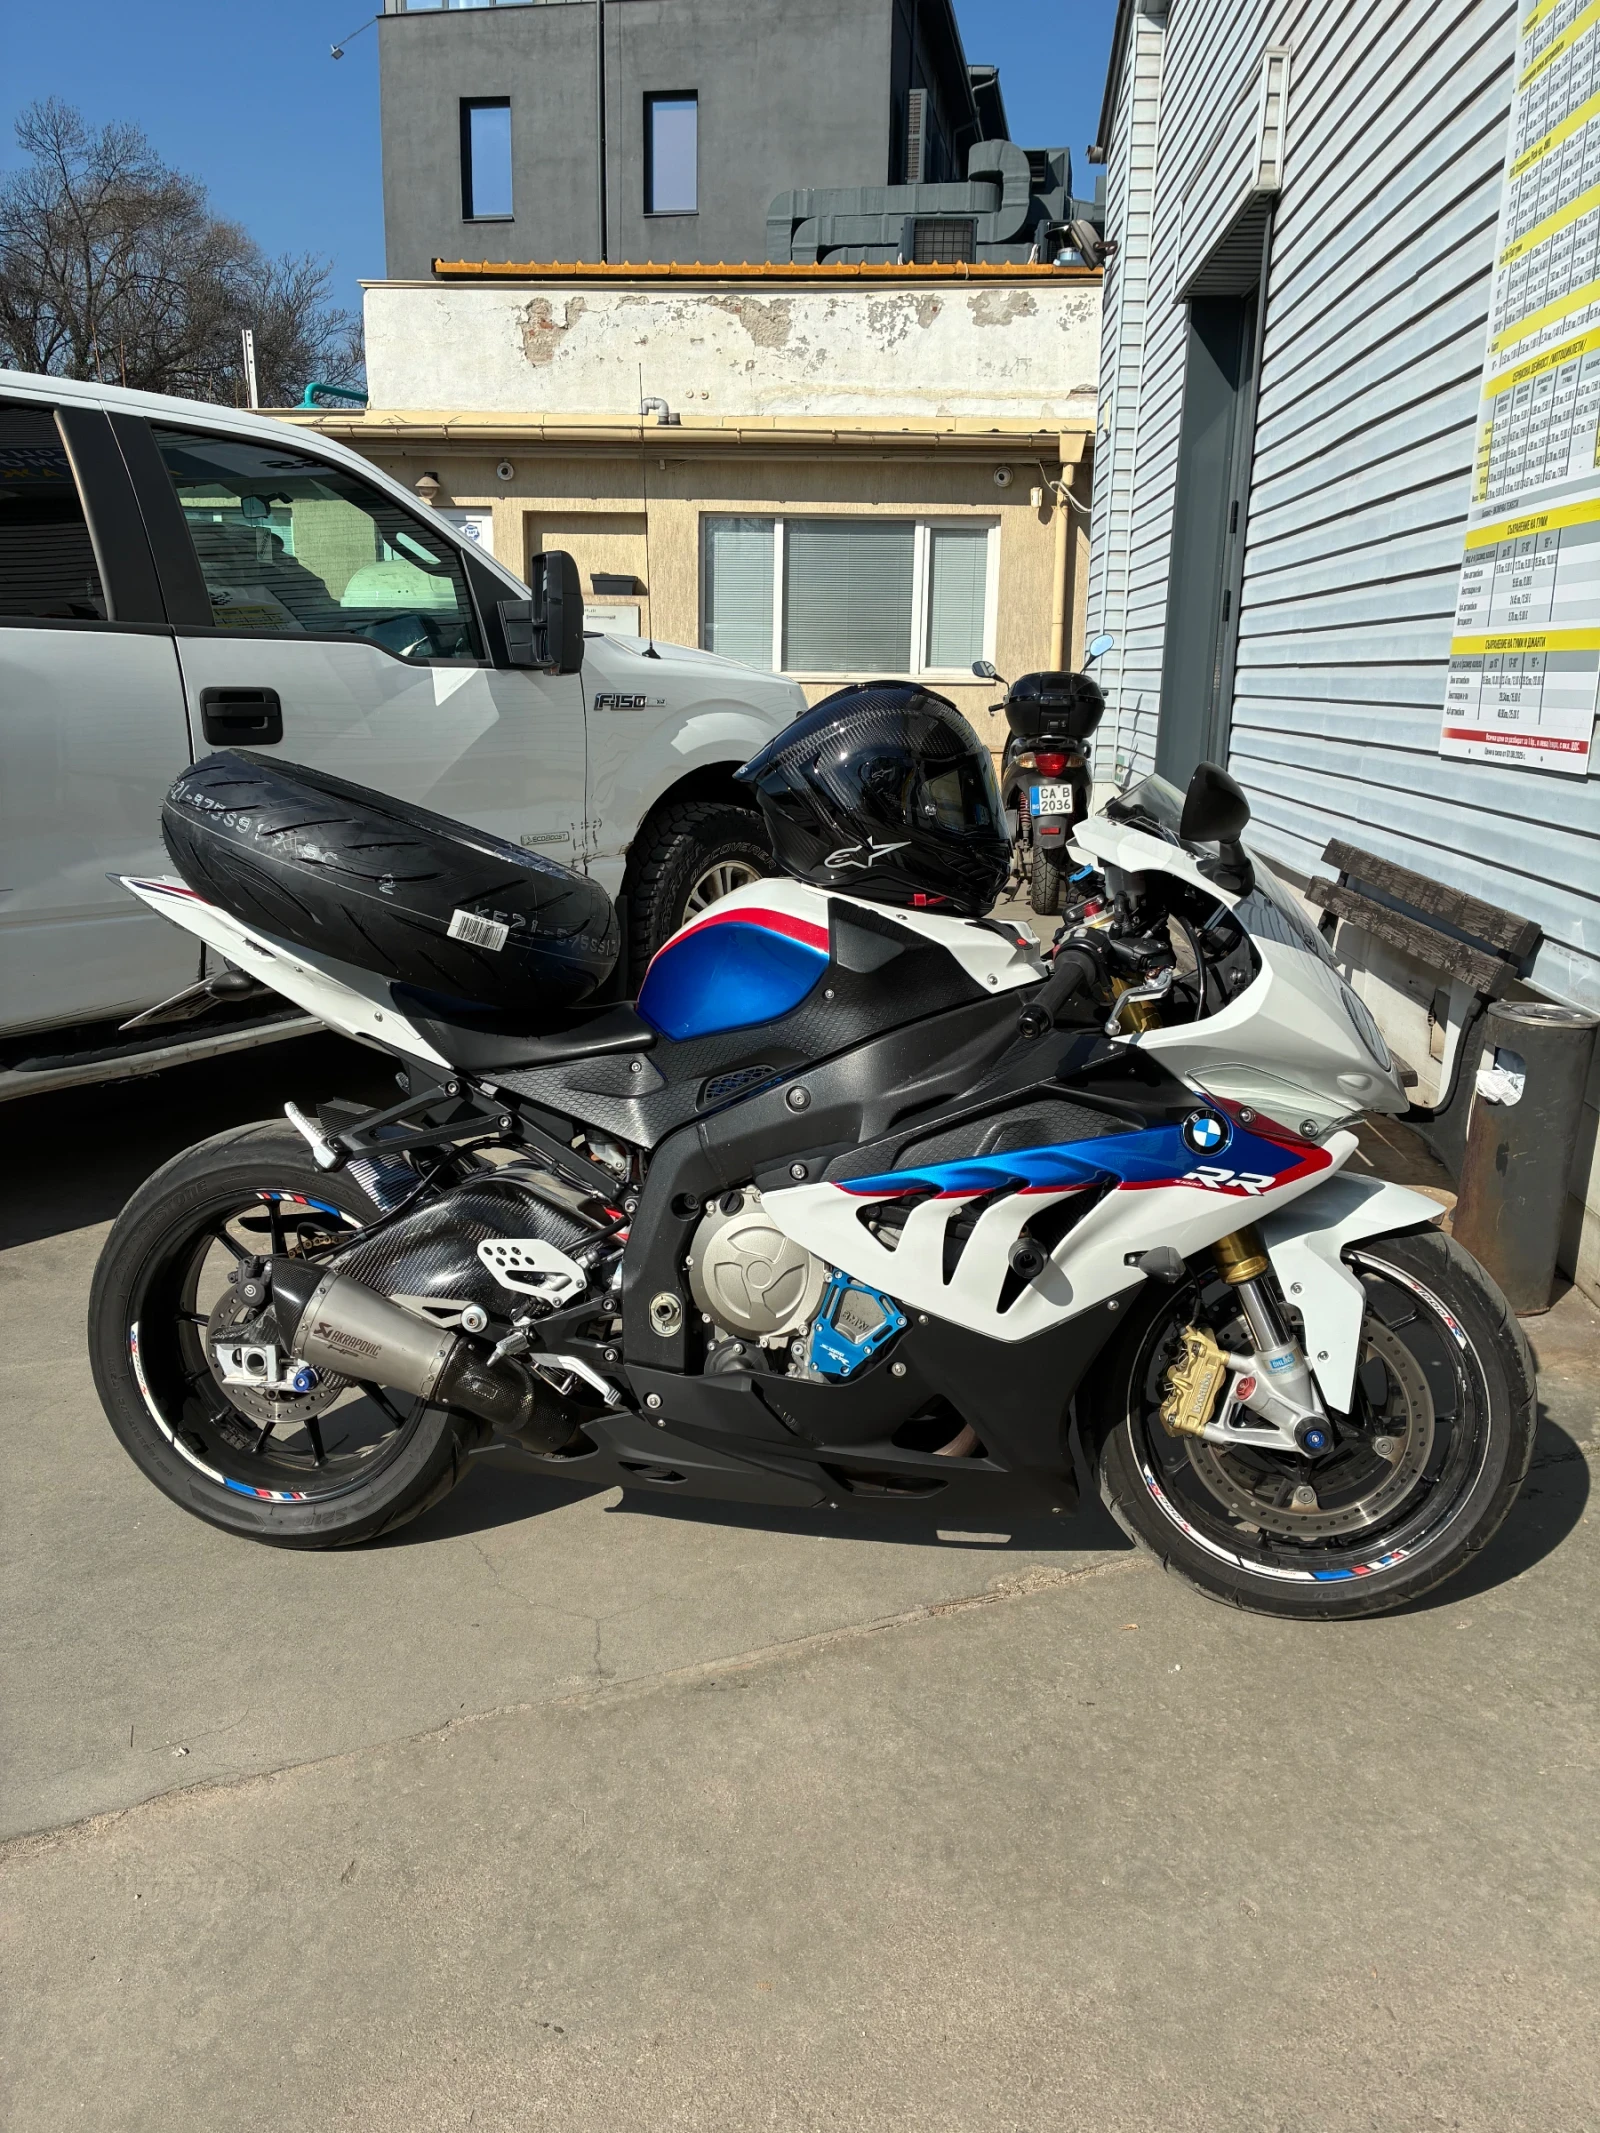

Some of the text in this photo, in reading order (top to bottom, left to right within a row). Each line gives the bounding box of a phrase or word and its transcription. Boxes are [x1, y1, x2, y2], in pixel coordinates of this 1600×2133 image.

[1536, 515, 1548, 528] ГУМИ
[1527, 636, 1546, 649] ДЖАНТИ
[596, 693, 646, 709] F-150
[1041, 787, 1070, 799] CA B
[1041, 800, 1071, 811] 2036
[532, 834, 567, 843] ECOBOOST
[690, 841, 777, 885] DISCOVERER
[1183, 1165, 1276, 1196] RR
[1191, 1372, 1213, 1414] brembo
